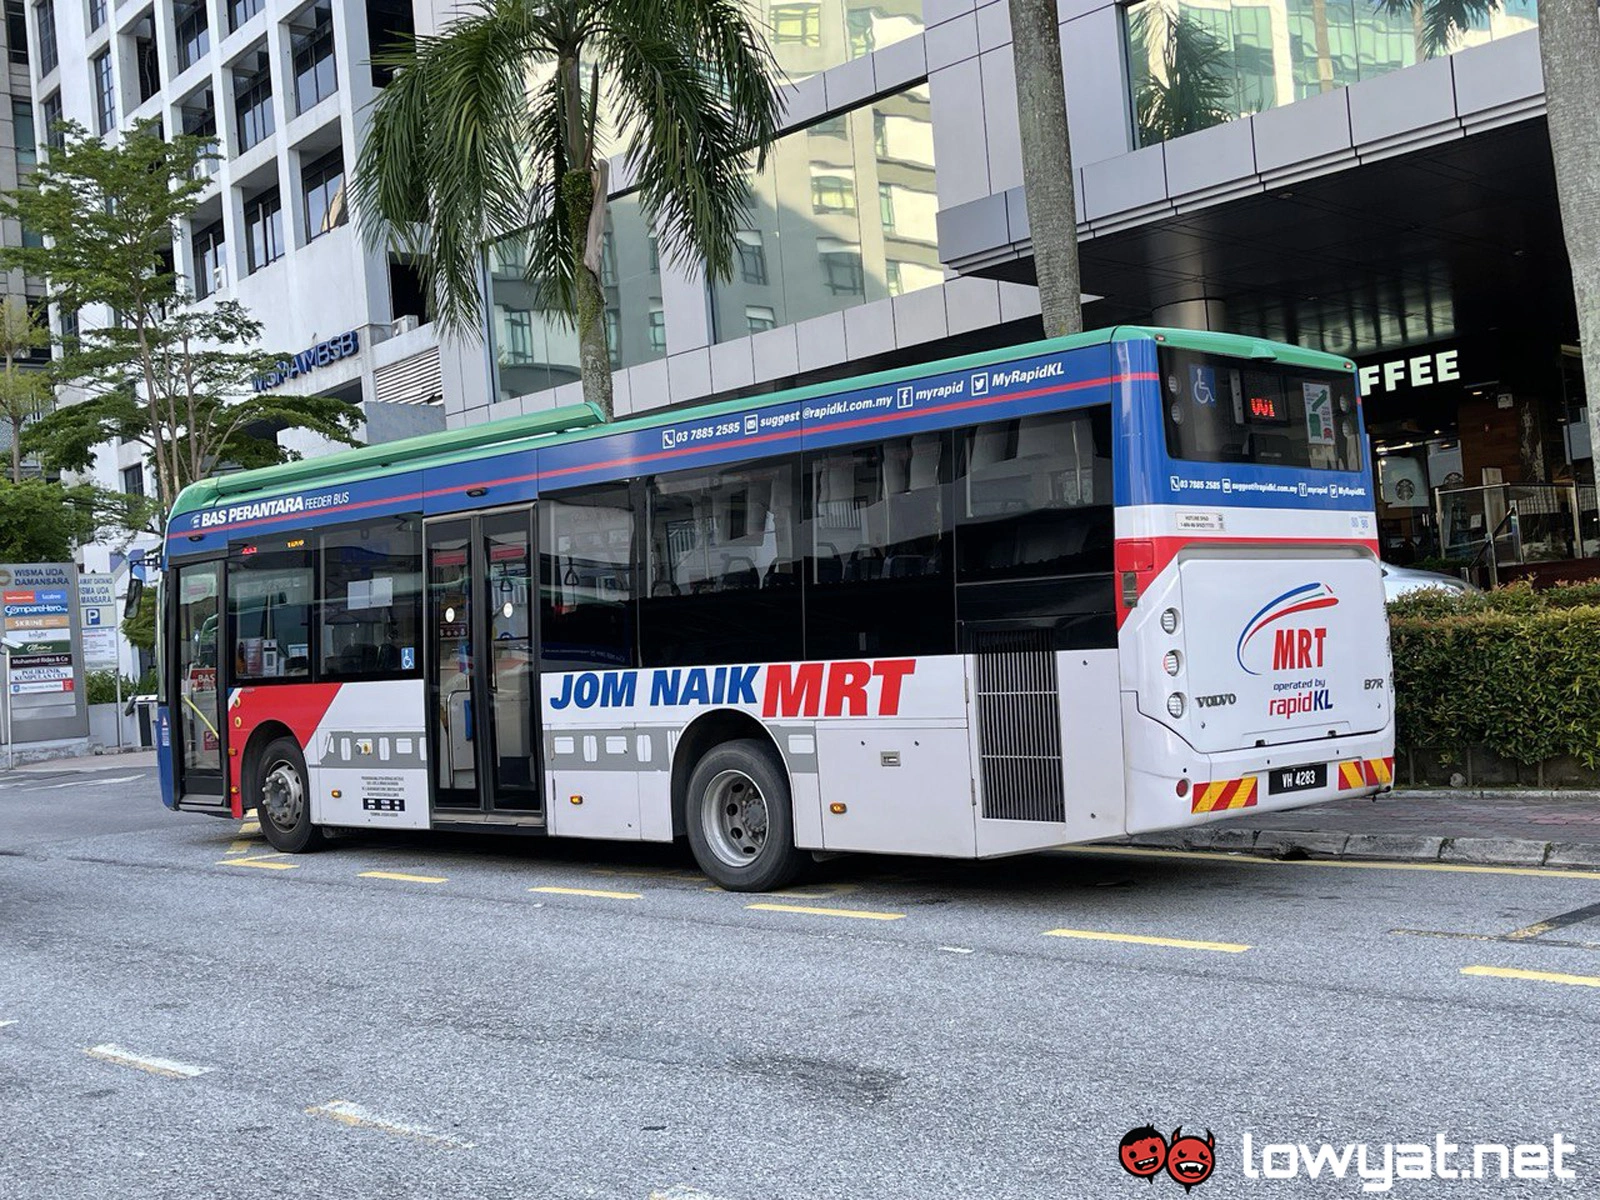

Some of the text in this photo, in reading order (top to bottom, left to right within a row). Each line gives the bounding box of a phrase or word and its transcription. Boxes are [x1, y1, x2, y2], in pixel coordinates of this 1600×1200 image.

[1358, 350, 1460, 396] FFEE
[676, 431, 688, 443] 03
[690, 427, 714, 441] 7885
[715, 421, 740, 436] 2585
[915, 380, 964, 401] myrapid
[992, 362, 1065, 388] MyRapidKL
[1180, 479, 1188, 489] 03
[202, 510, 227, 527] BAS
[229, 496, 304, 522] PERANTARA
[305, 496, 333, 510] FEEDER
[333, 491, 350, 504] BUS
[14, 569, 43, 577] WISMA
[14, 577, 70, 586] DAMANSARA
[15, 619, 43, 627] SKRINE
[88, 609, 99, 625] P
[1273, 628, 1327, 670] MRT
[550, 659, 917, 718] JOM NAIK MRT
[1273, 678, 1326, 692] operated by
[1364, 678, 1384, 690] B7R
[1195, 693, 1237, 708] VOLVO
[1269, 689, 1333, 719] rapidKL
[1282, 770, 1315, 788] VH 4283
